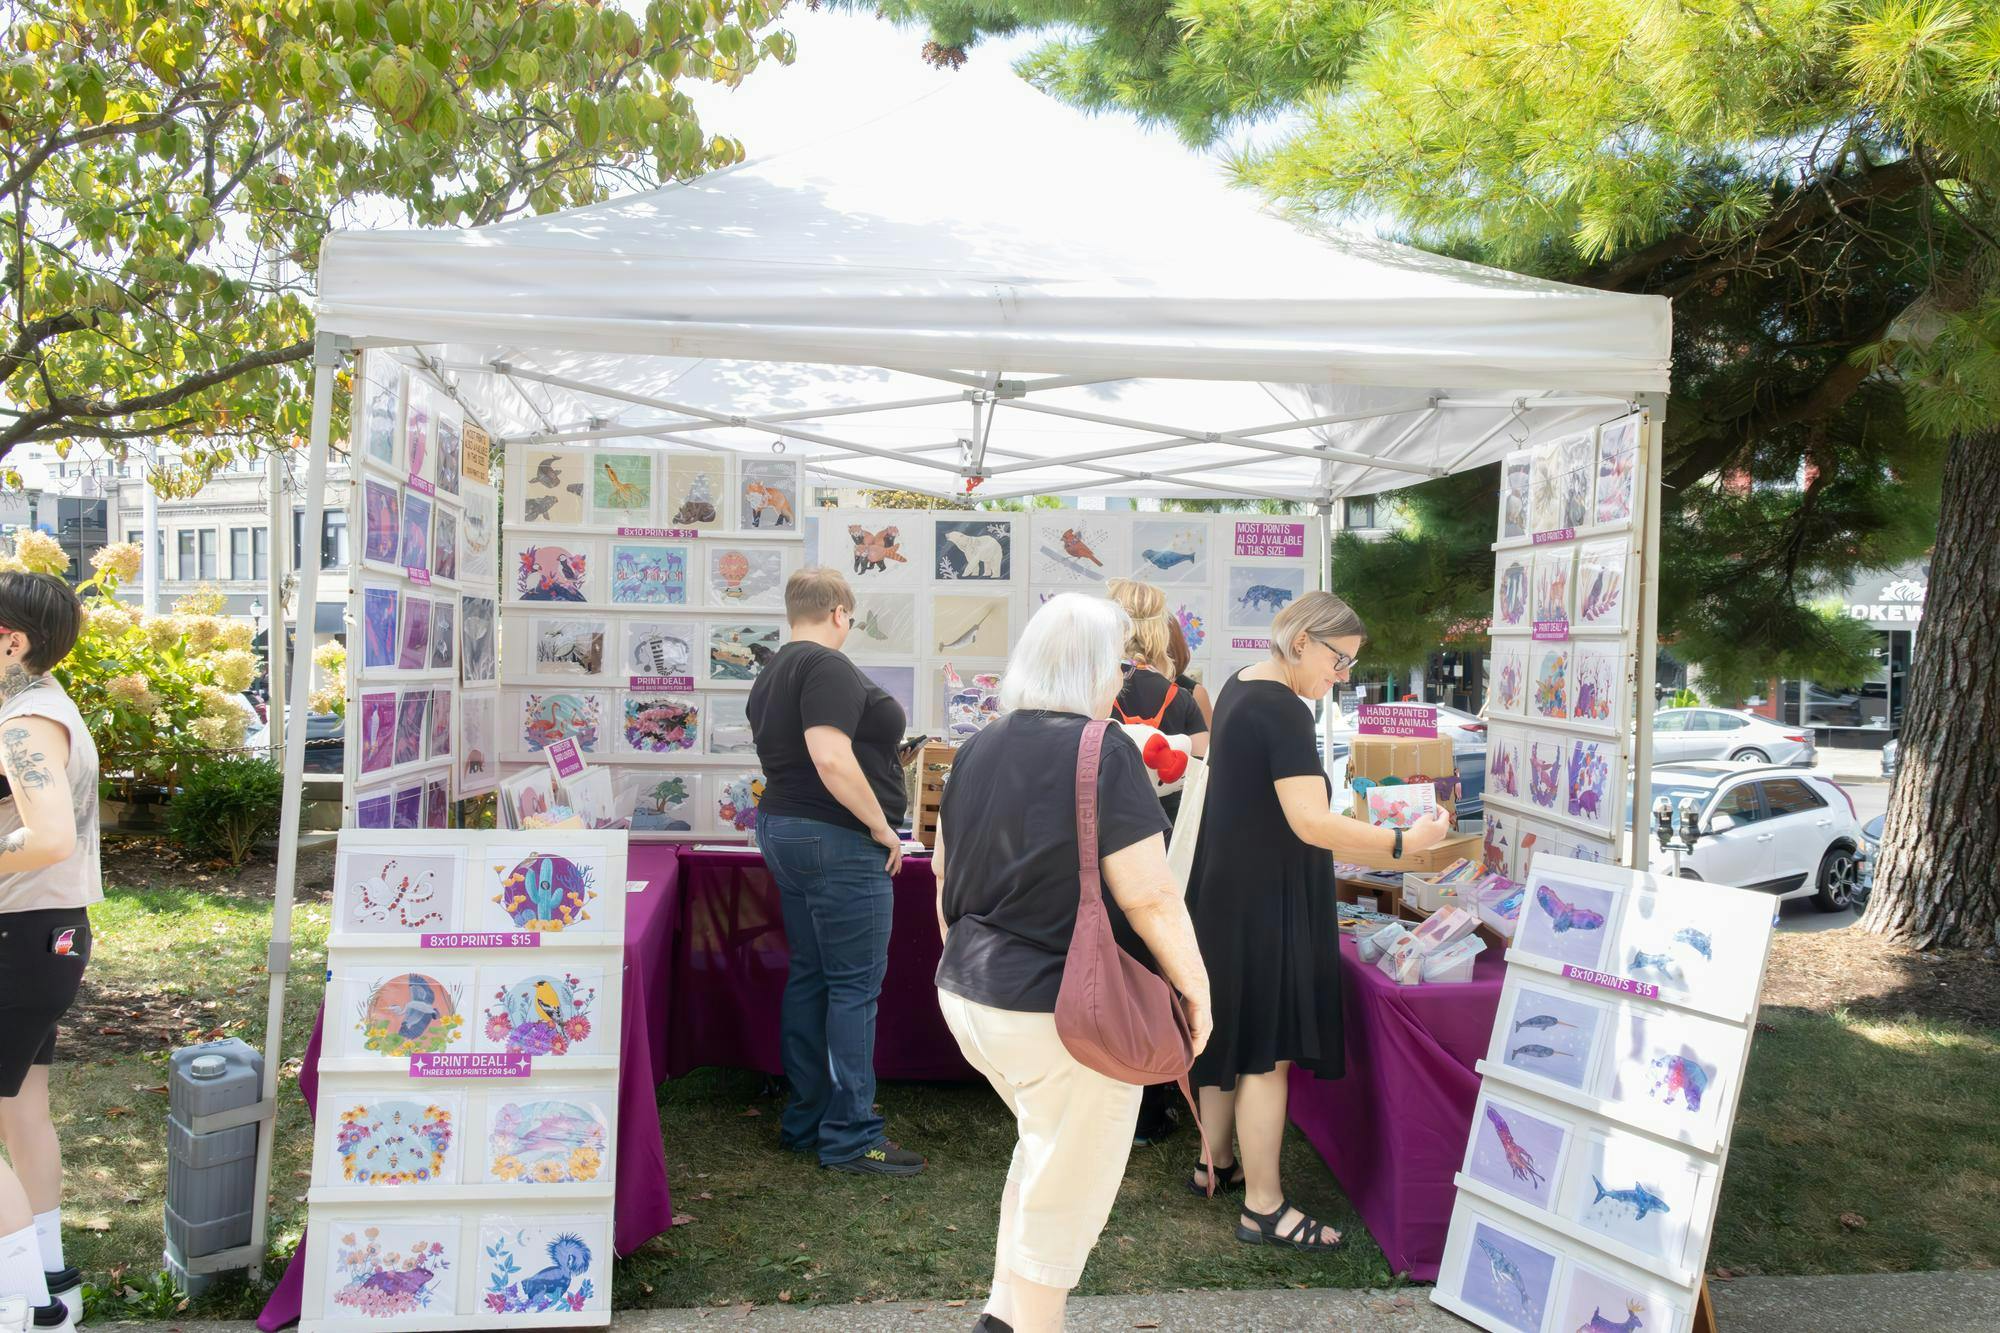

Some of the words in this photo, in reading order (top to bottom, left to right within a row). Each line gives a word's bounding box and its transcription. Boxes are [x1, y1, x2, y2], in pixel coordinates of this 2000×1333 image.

[624, 528, 643, 536] 8x10
[644, 528, 673, 537] PRINTS
[679, 529, 693, 537] $15
[1237, 524, 1260, 533] MOST
[1263, 524, 1290, 534] PRINTS
[1237, 534, 1258, 544] ALSO
[1261, 535, 1302, 545] AVAILABLE
[1236, 545, 1244, 554] IN
[1247, 545, 1264, 555] THIS
[1266, 546, 1286, 556] SIZE!
[1254, 639, 1270, 648] PRIN
[637, 677, 661, 685] PRINT
[663, 677, 686, 685] DEAL!
[1366, 706, 1391, 716] HAND
[1392, 707, 1429, 718] PAINTED
[1358, 716, 1397, 726] WOODEN
[1398, 717, 1437, 728] ANIMALS
[1382, 726, 1395, 734] $20
[1396, 727, 1414, 735] EACH
[430, 935, 458, 946] 8x10
[461, 934, 503, 946] PRINTS
[511, 934, 531, 946] $15
[1570, 967, 1594, 981] 8x10
[1595, 973, 1630, 990] PRINTS
[1635, 982, 1652, 996] $15
[432, 1055, 469, 1067] PRINT
[472, 1055, 507, 1067] DEAL!
[422, 1068, 445, 1076] THREE
[445, 1068, 461, 1076] 8X10
[463, 1068, 487, 1076] PRINTS
